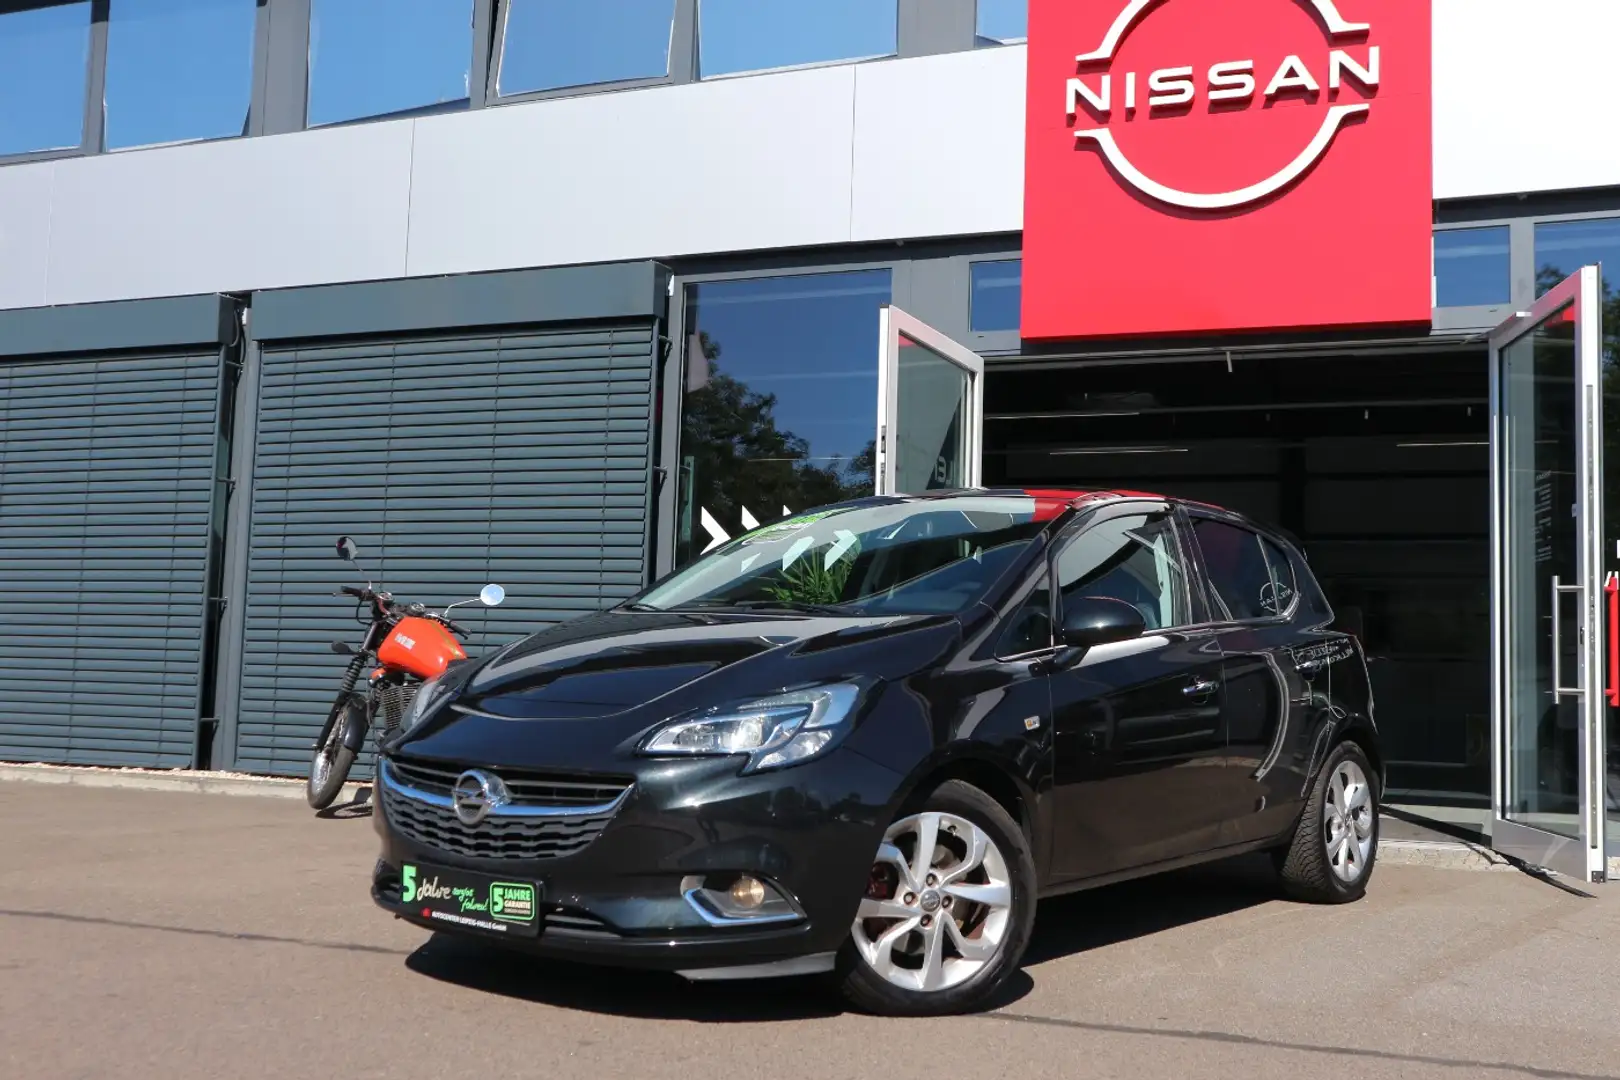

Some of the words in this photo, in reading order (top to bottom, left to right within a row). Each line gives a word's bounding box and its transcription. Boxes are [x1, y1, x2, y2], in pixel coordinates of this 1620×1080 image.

[1066, 46, 1380, 114] NISSAN
[403, 865, 417, 902] 5
[417, 876, 451, 901] Jahre
[493, 887, 504, 912] 5
[504, 888, 531, 901] JAHRE
